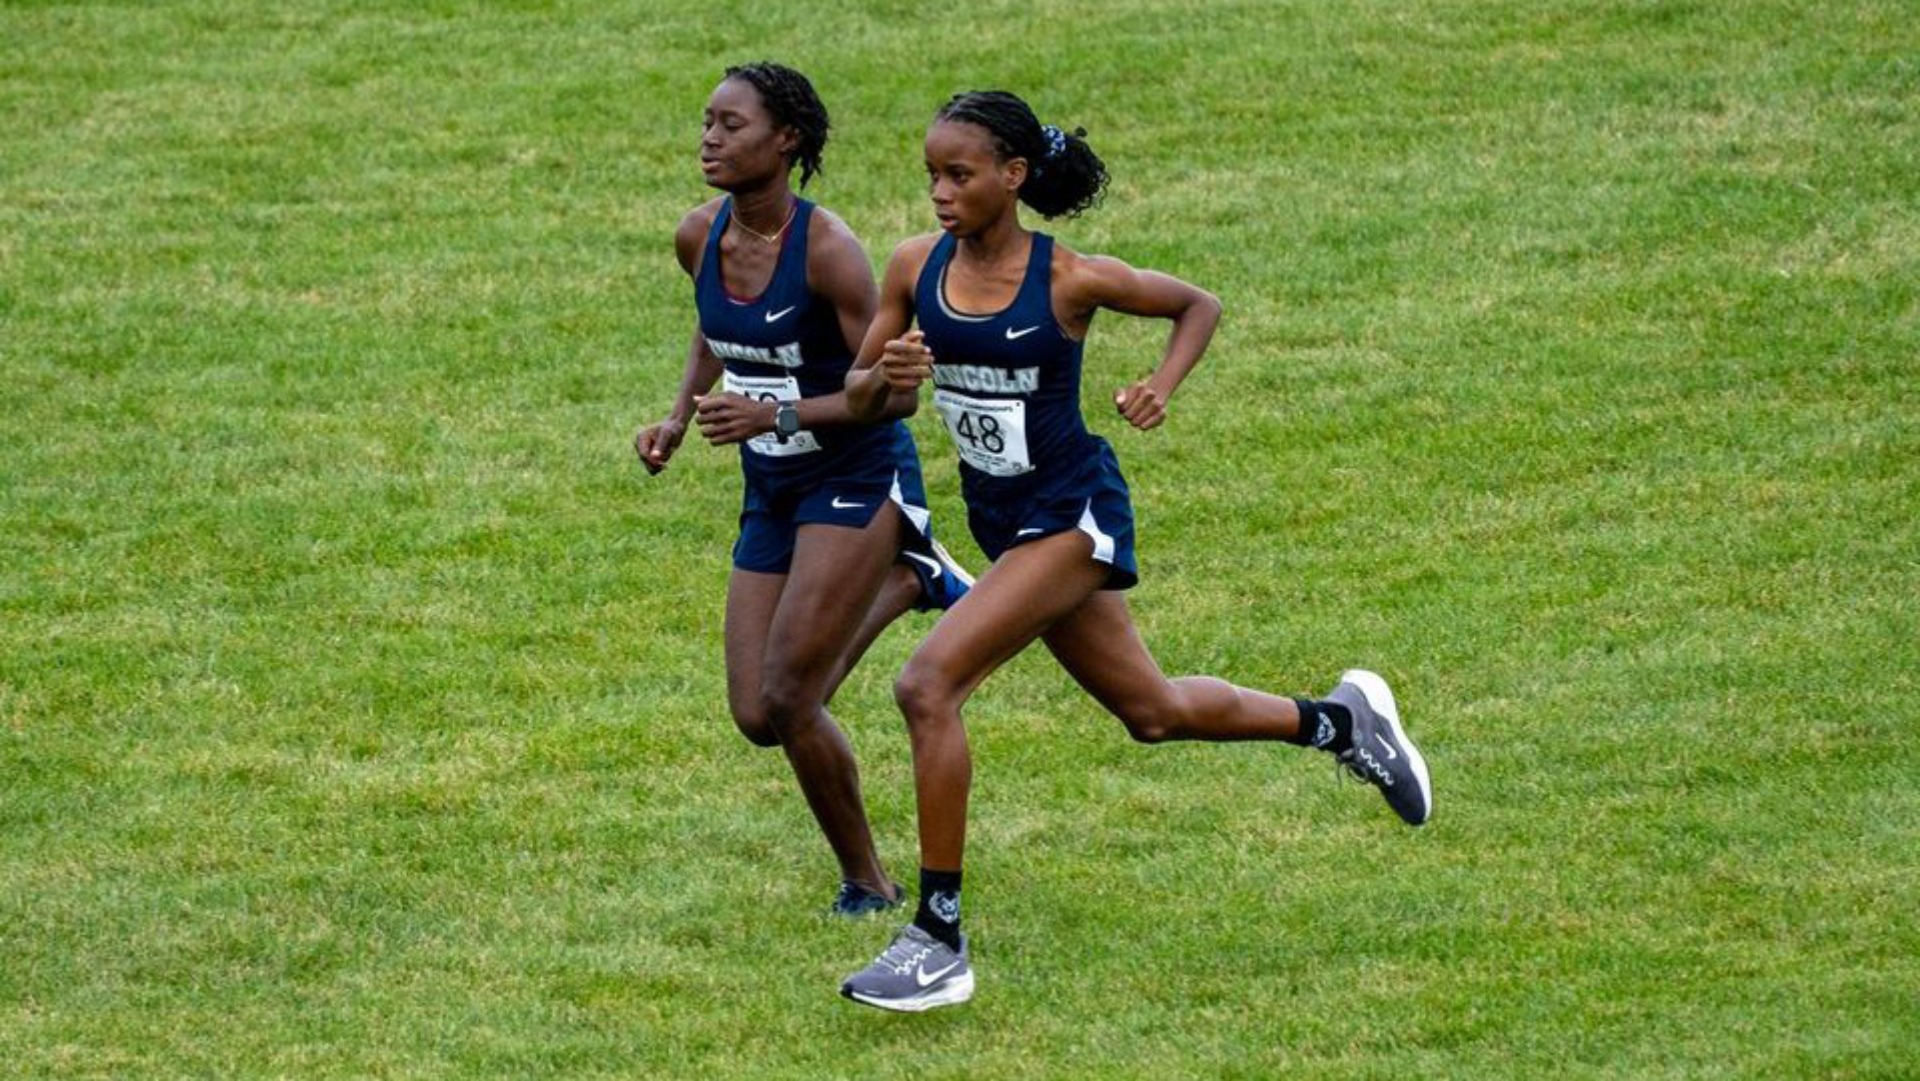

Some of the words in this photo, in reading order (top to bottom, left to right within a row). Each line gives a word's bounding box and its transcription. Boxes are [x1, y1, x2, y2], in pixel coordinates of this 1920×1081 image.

[706, 338, 803, 368] INCOLN
[933, 363, 1040, 393] INCOLN
[957, 411, 1005, 454] 48
